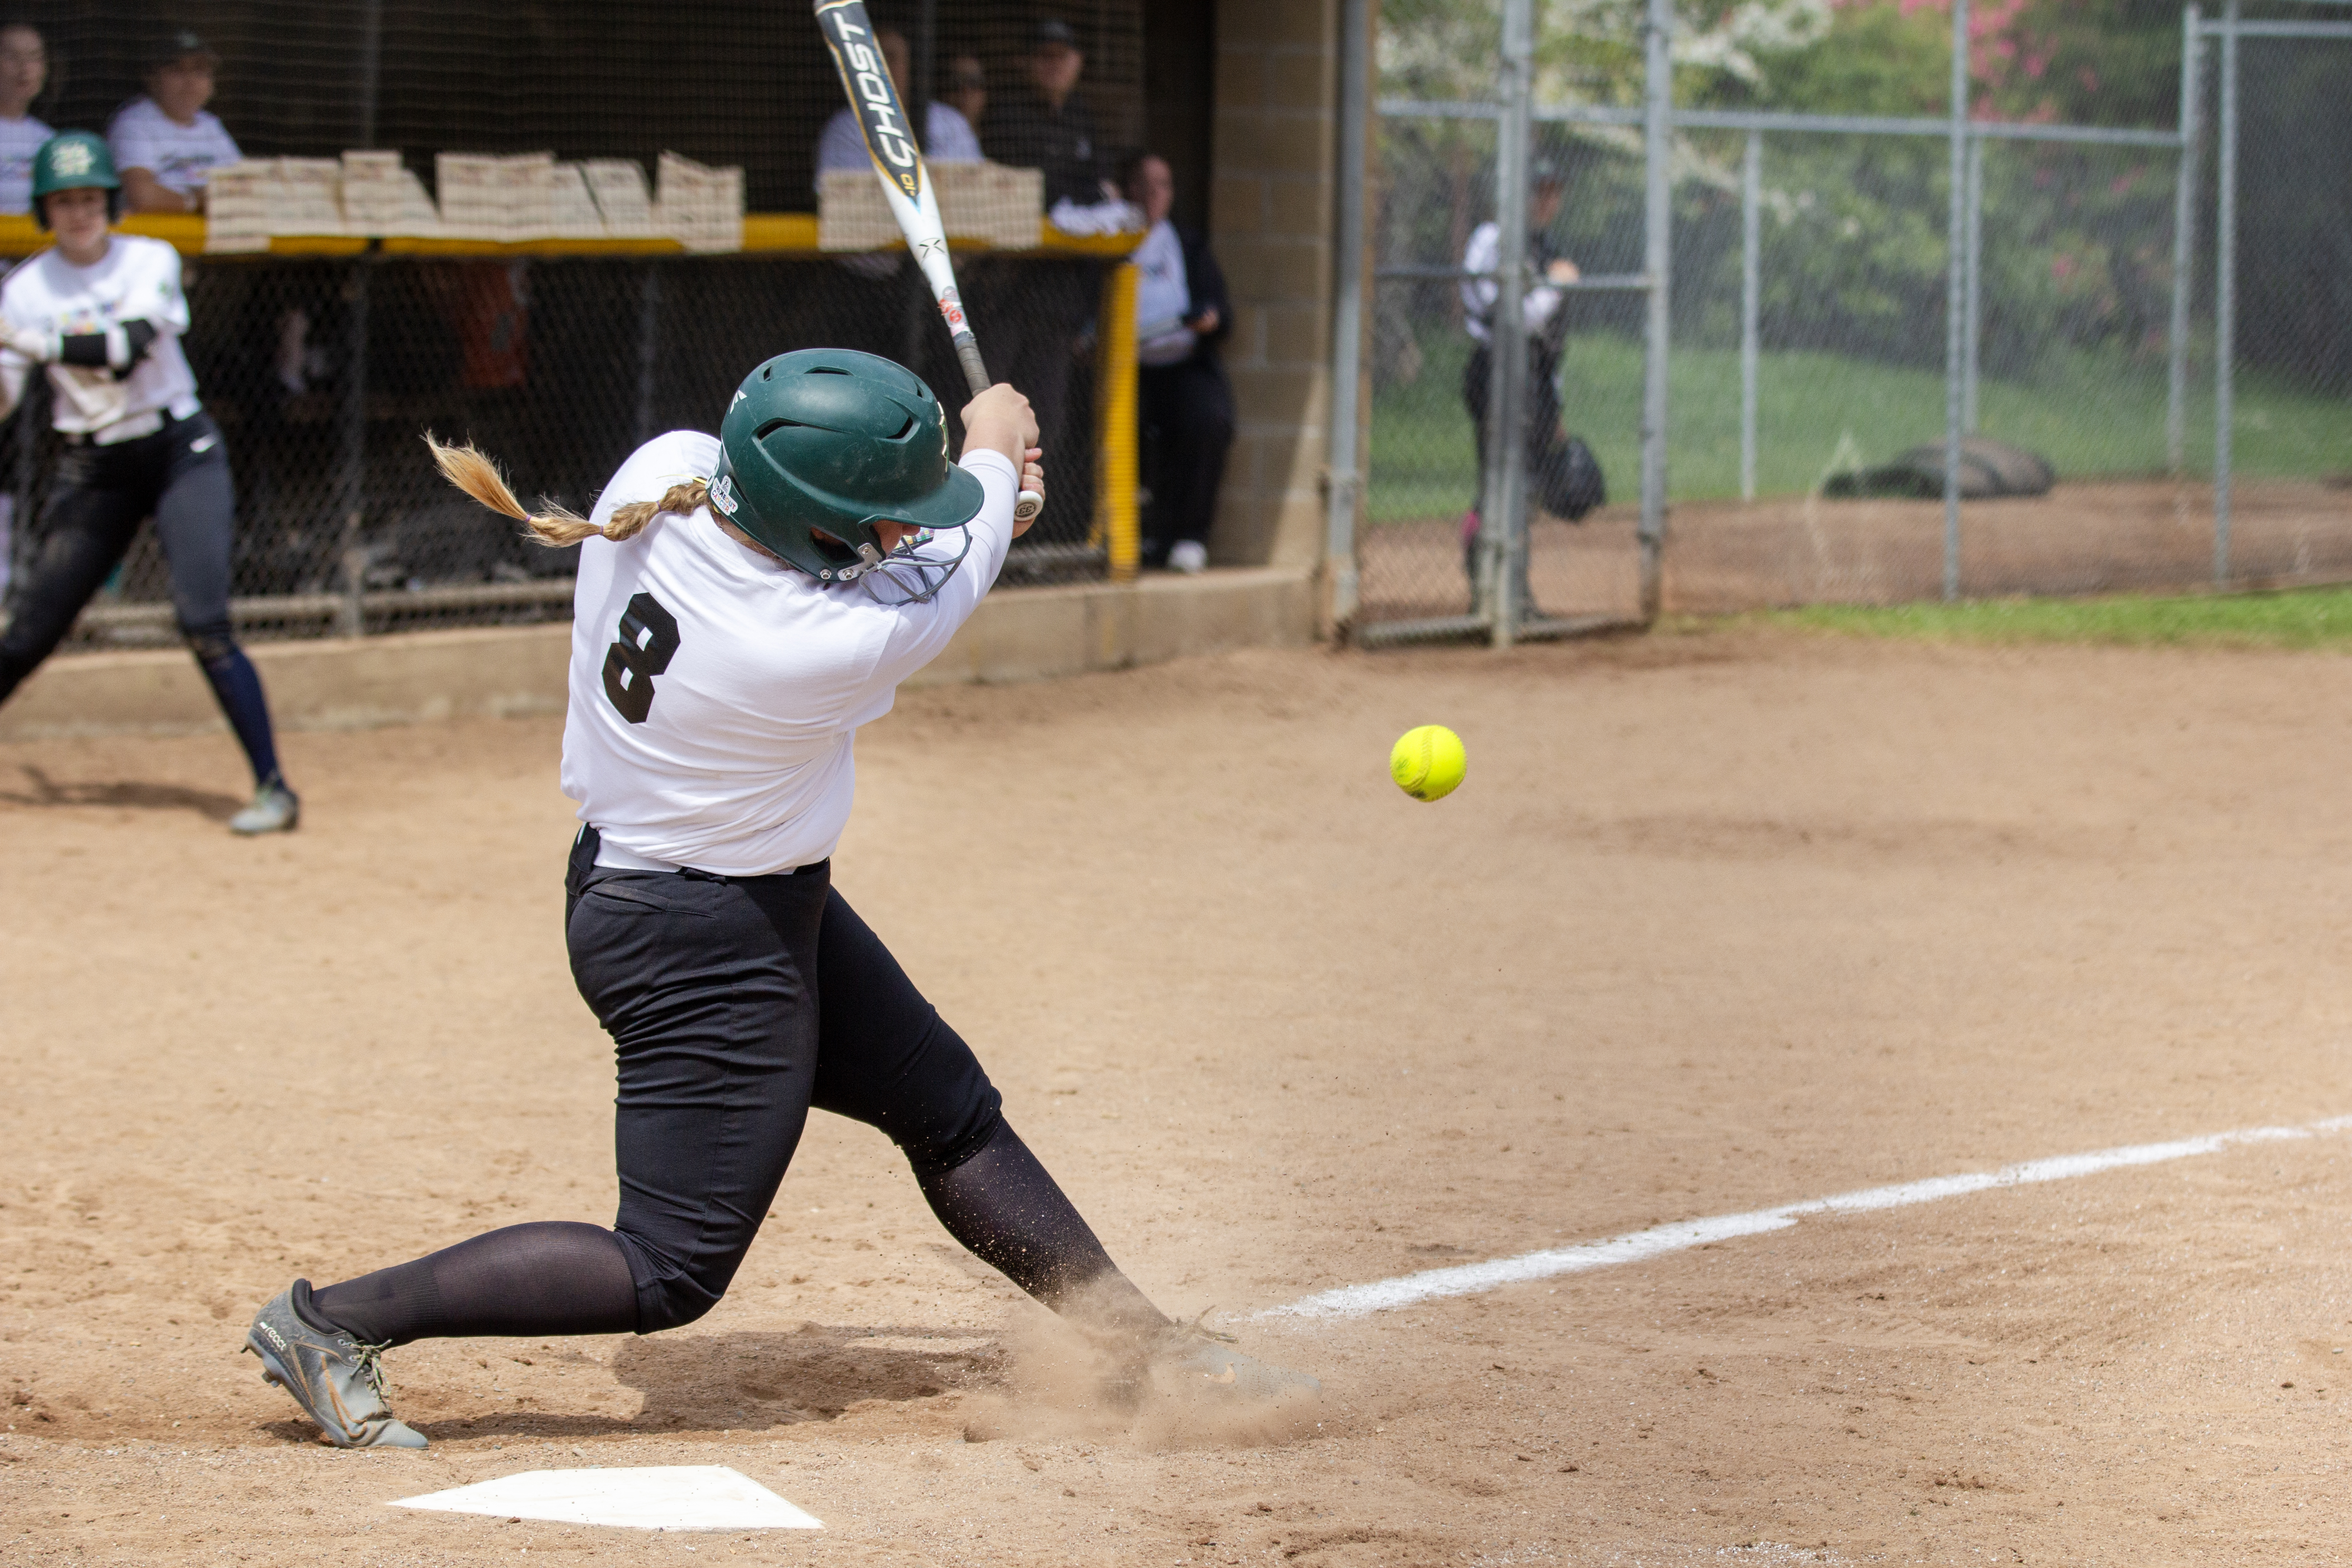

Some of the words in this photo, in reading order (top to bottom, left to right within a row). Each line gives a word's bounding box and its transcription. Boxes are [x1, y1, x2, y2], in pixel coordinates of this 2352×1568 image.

[833, 12, 918, 167] GHOST
[712, 490, 730, 513] CANCER
[602, 592, 681, 724] 8
[265, 1327, 287, 1351] react
